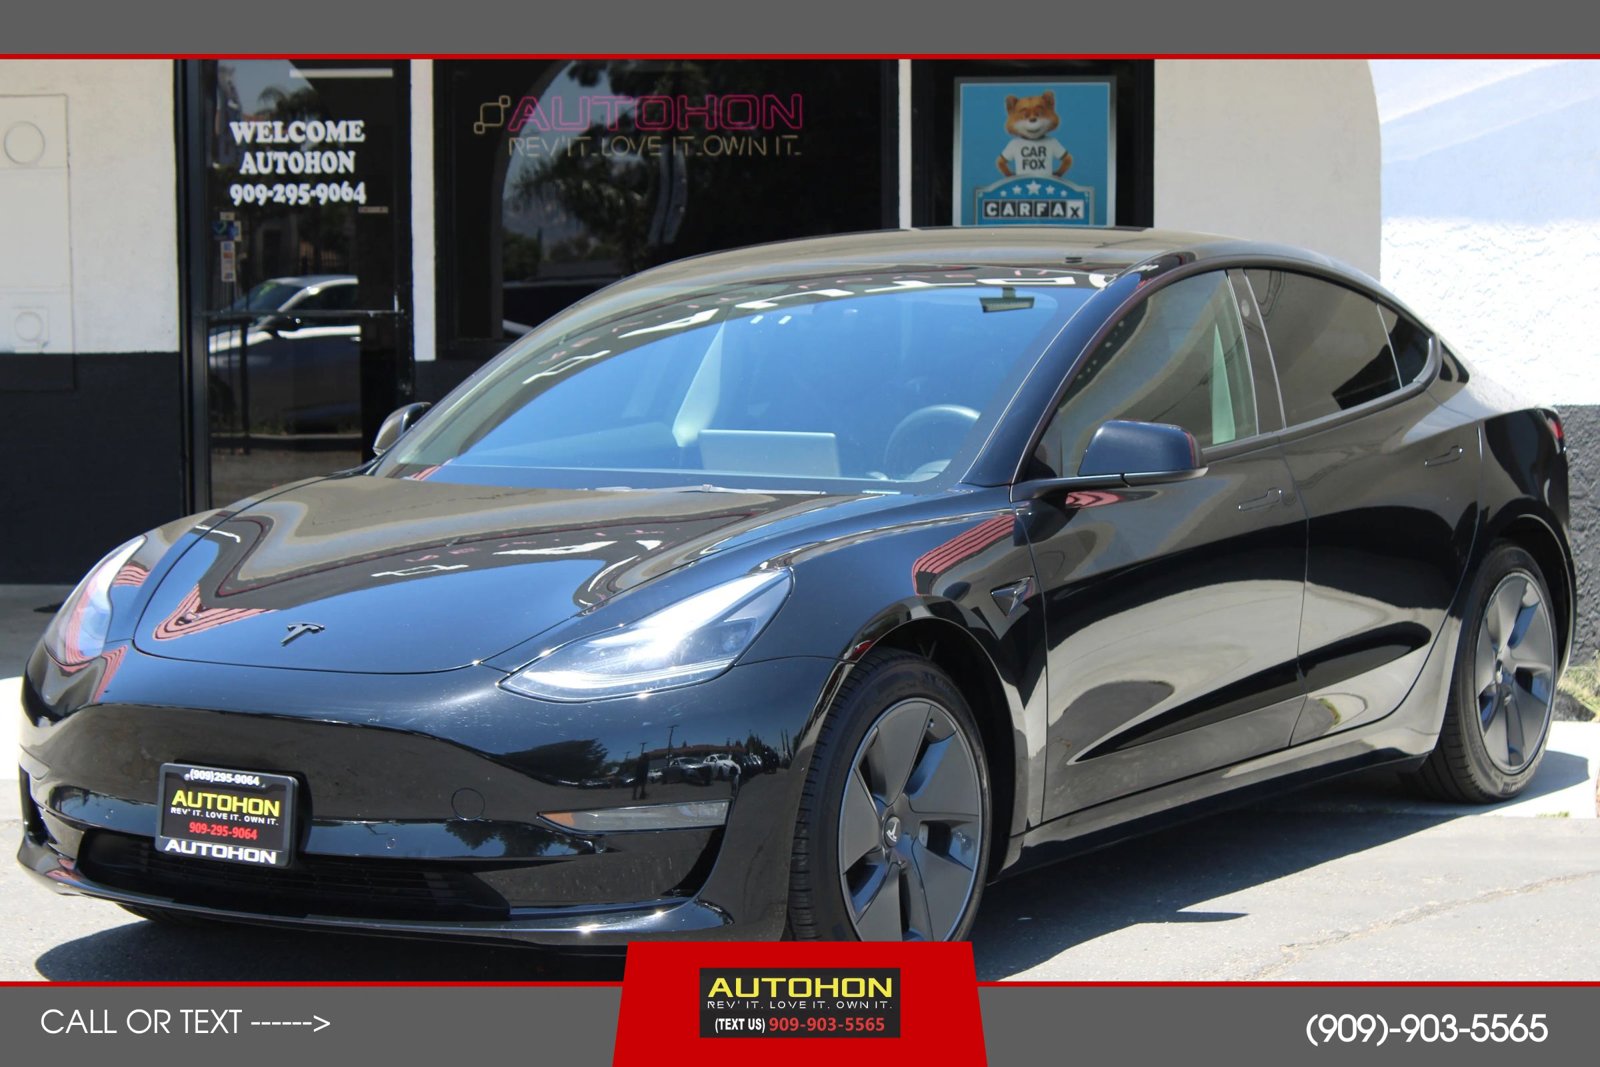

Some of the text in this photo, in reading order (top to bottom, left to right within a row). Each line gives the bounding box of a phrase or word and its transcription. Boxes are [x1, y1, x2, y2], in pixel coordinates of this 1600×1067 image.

[507, 94, 803, 132] AUTOHON
[229, 120, 366, 145] WELCOME
[601, 135, 662, 156] LOVE
[703, 134, 767, 156] OWN
[1021, 146, 1047, 158] CAR
[239, 151, 356, 174] AUTOHON
[1022, 159, 1046, 170] FOX
[229, 181, 367, 206] 909-295-9064
[189, 768, 260, 786] (909)295-9064
[171, 789, 280, 818] AUTOHON
[205, 812, 228, 820] LOVE
[229, 814, 242, 822] IT.
[243, 815, 265, 824] OWN
[266, 818, 279, 826] IT.
[188, 821, 258, 841] 909-295-9064
[164, 838, 277, 865] AUTOHON
